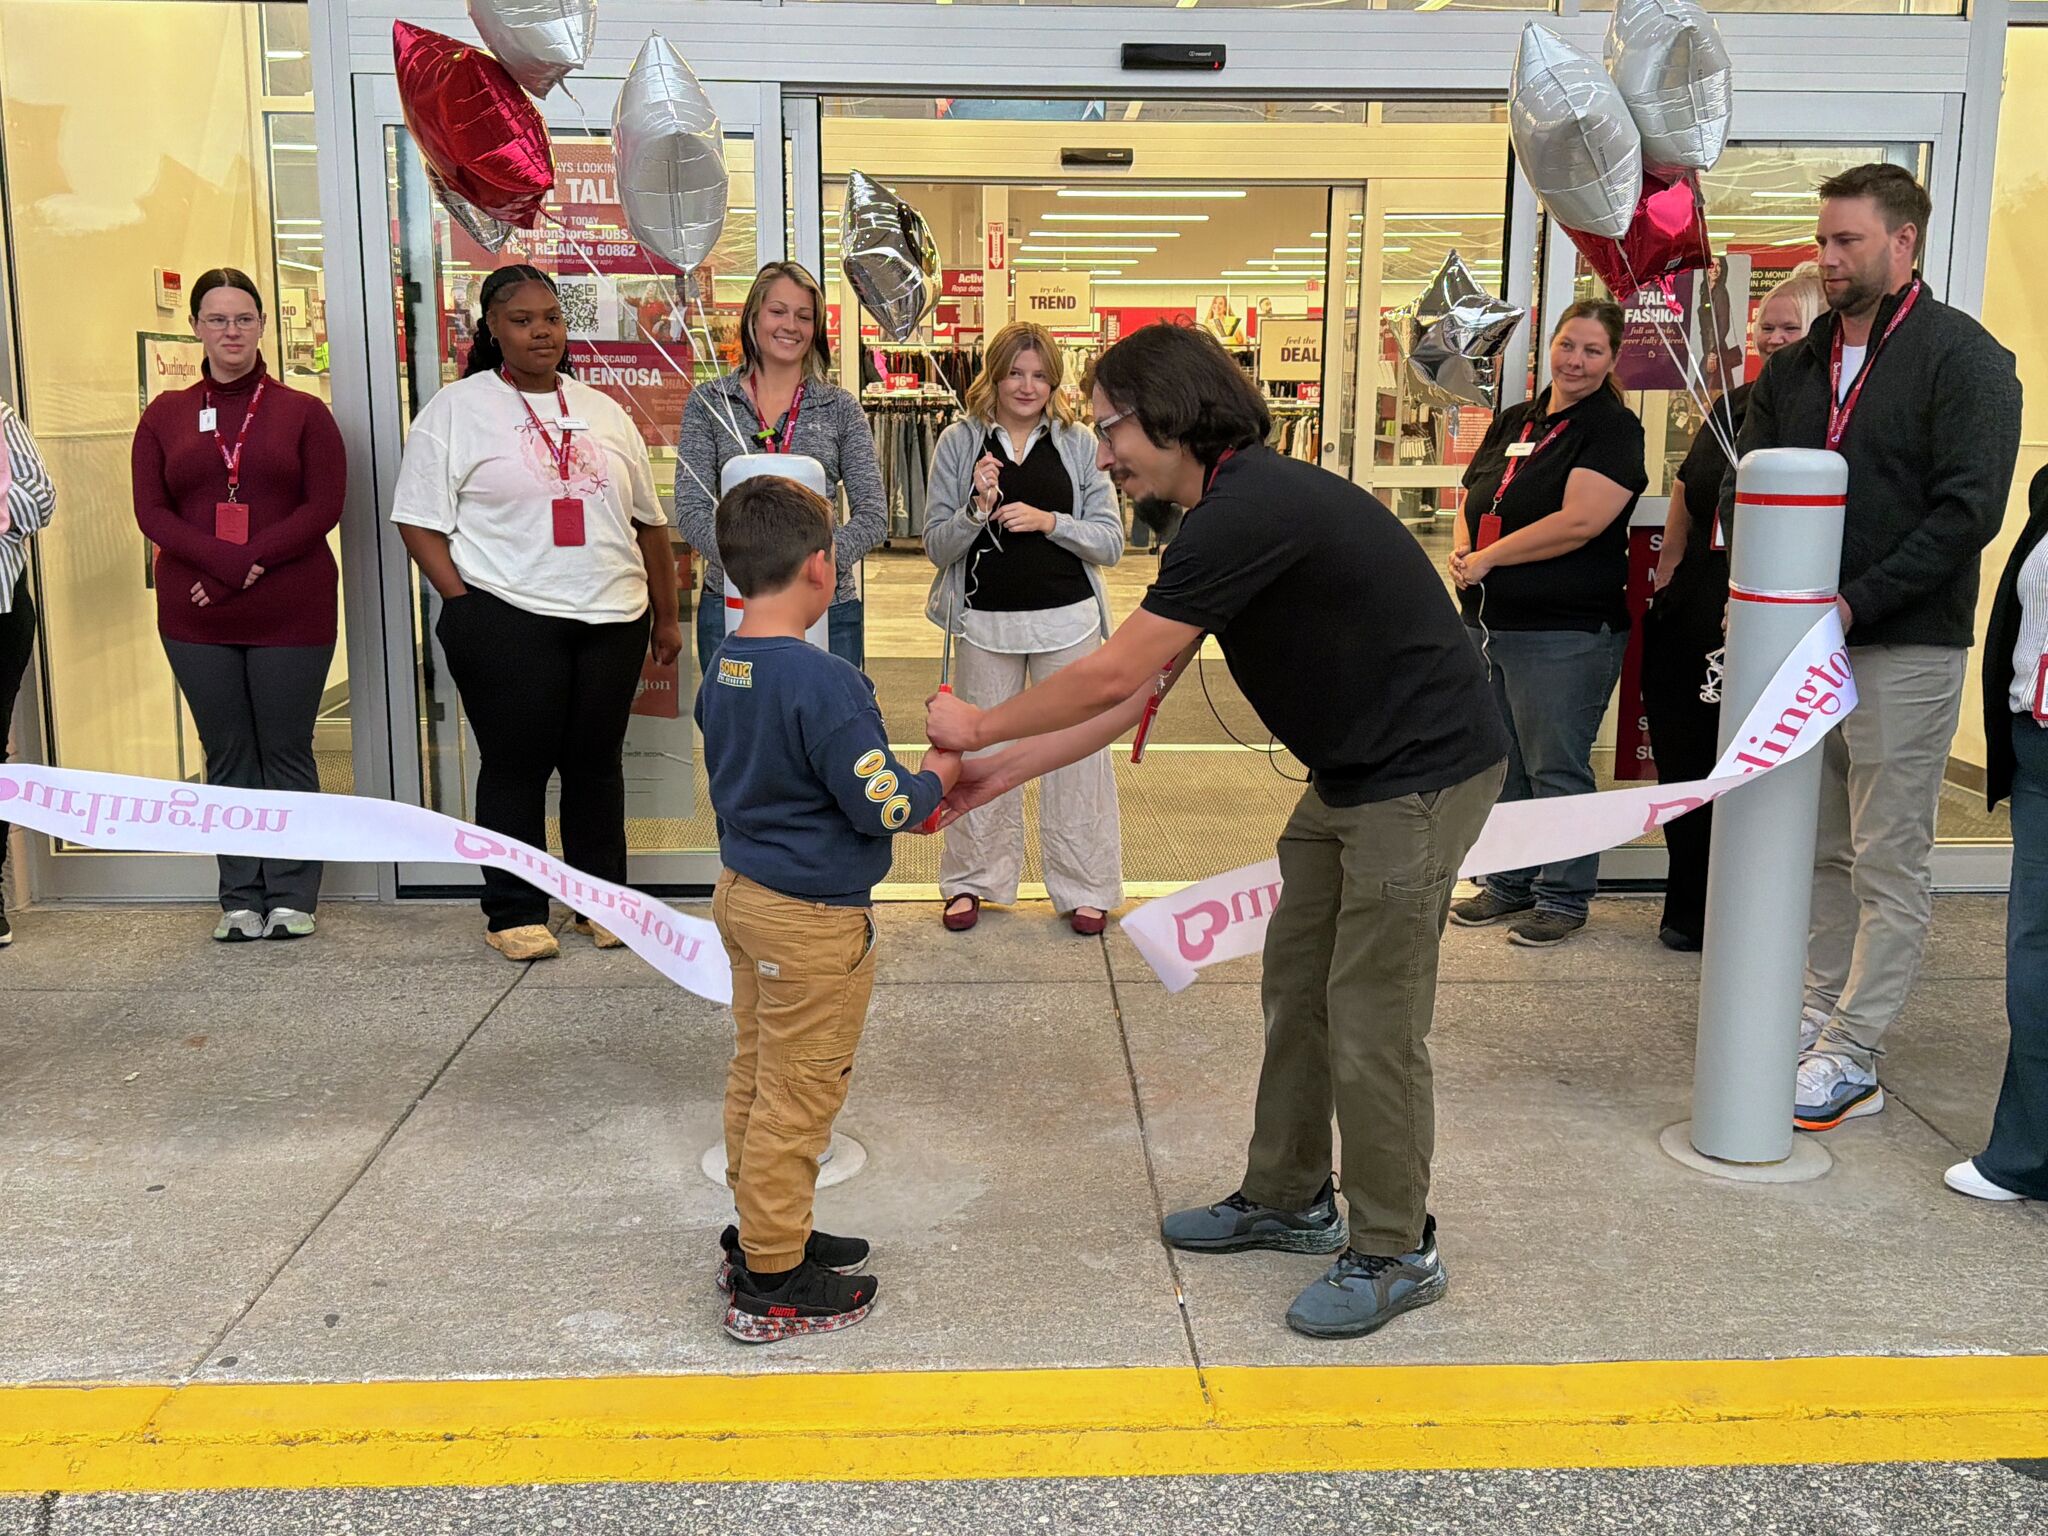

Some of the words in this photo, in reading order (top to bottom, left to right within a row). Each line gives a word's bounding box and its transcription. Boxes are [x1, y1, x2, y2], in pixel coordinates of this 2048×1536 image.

[571, 216, 599, 226] TODAY
[505, 242, 531, 255] Tet
[536, 243, 578, 256] RETAIL
[597, 244, 637, 257] 60862
[1040, 287, 1051, 295] try
[1053, 285, 1066, 293] the
[1029, 296, 1077, 310] TREND
[1624, 309, 1684, 323] FASHION
[1285, 336, 1301, 346] feel
[1303, 336, 1316, 344] the
[1281, 347, 1320, 362] DEAL
[719, 661, 750, 678] SONIC
[1733, 644, 1852, 775] lingto
[767, 1306, 798, 1318] PUMA
